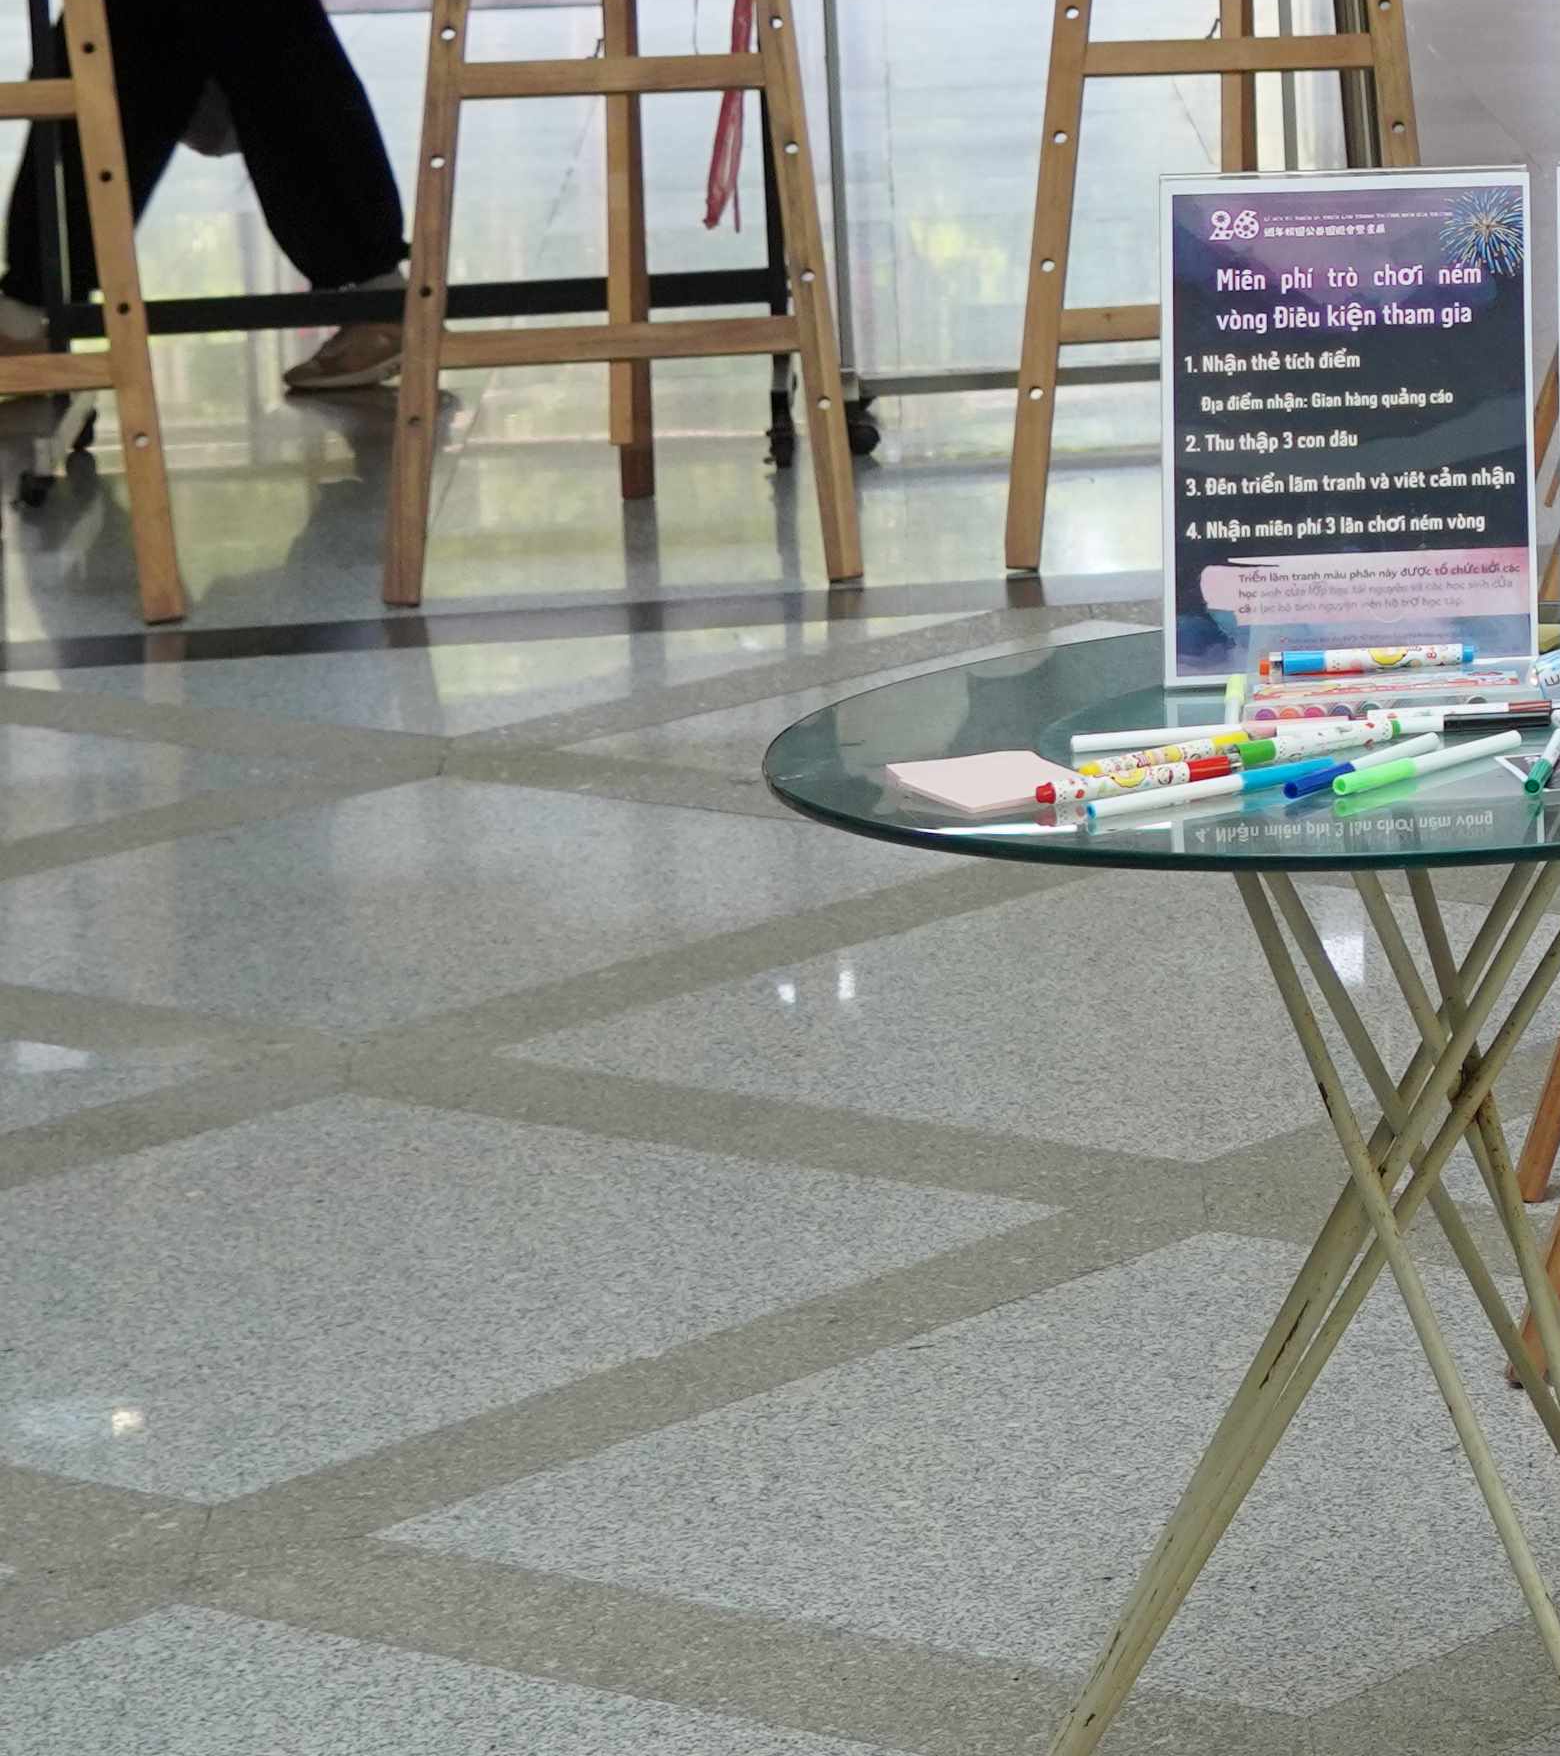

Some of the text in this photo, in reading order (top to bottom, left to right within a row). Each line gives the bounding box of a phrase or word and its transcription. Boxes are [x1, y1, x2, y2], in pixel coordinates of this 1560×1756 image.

[1327, 266, 1359, 289] trò
[1215, 307, 1268, 335] vòng
[1381, 302, 1436, 326] tham
[1441, 301, 1473, 328] gia
[1311, 392, 1341, 408] Gian
[1204, 434, 1235, 453] Thu
[1282, 431, 1293, 450] 3
[1297, 435, 1326, 450] con
[1322, 472, 1367, 492] tranh
[1325, 517, 1336, 535] 3
[1447, 512, 1486, 532] vòng
